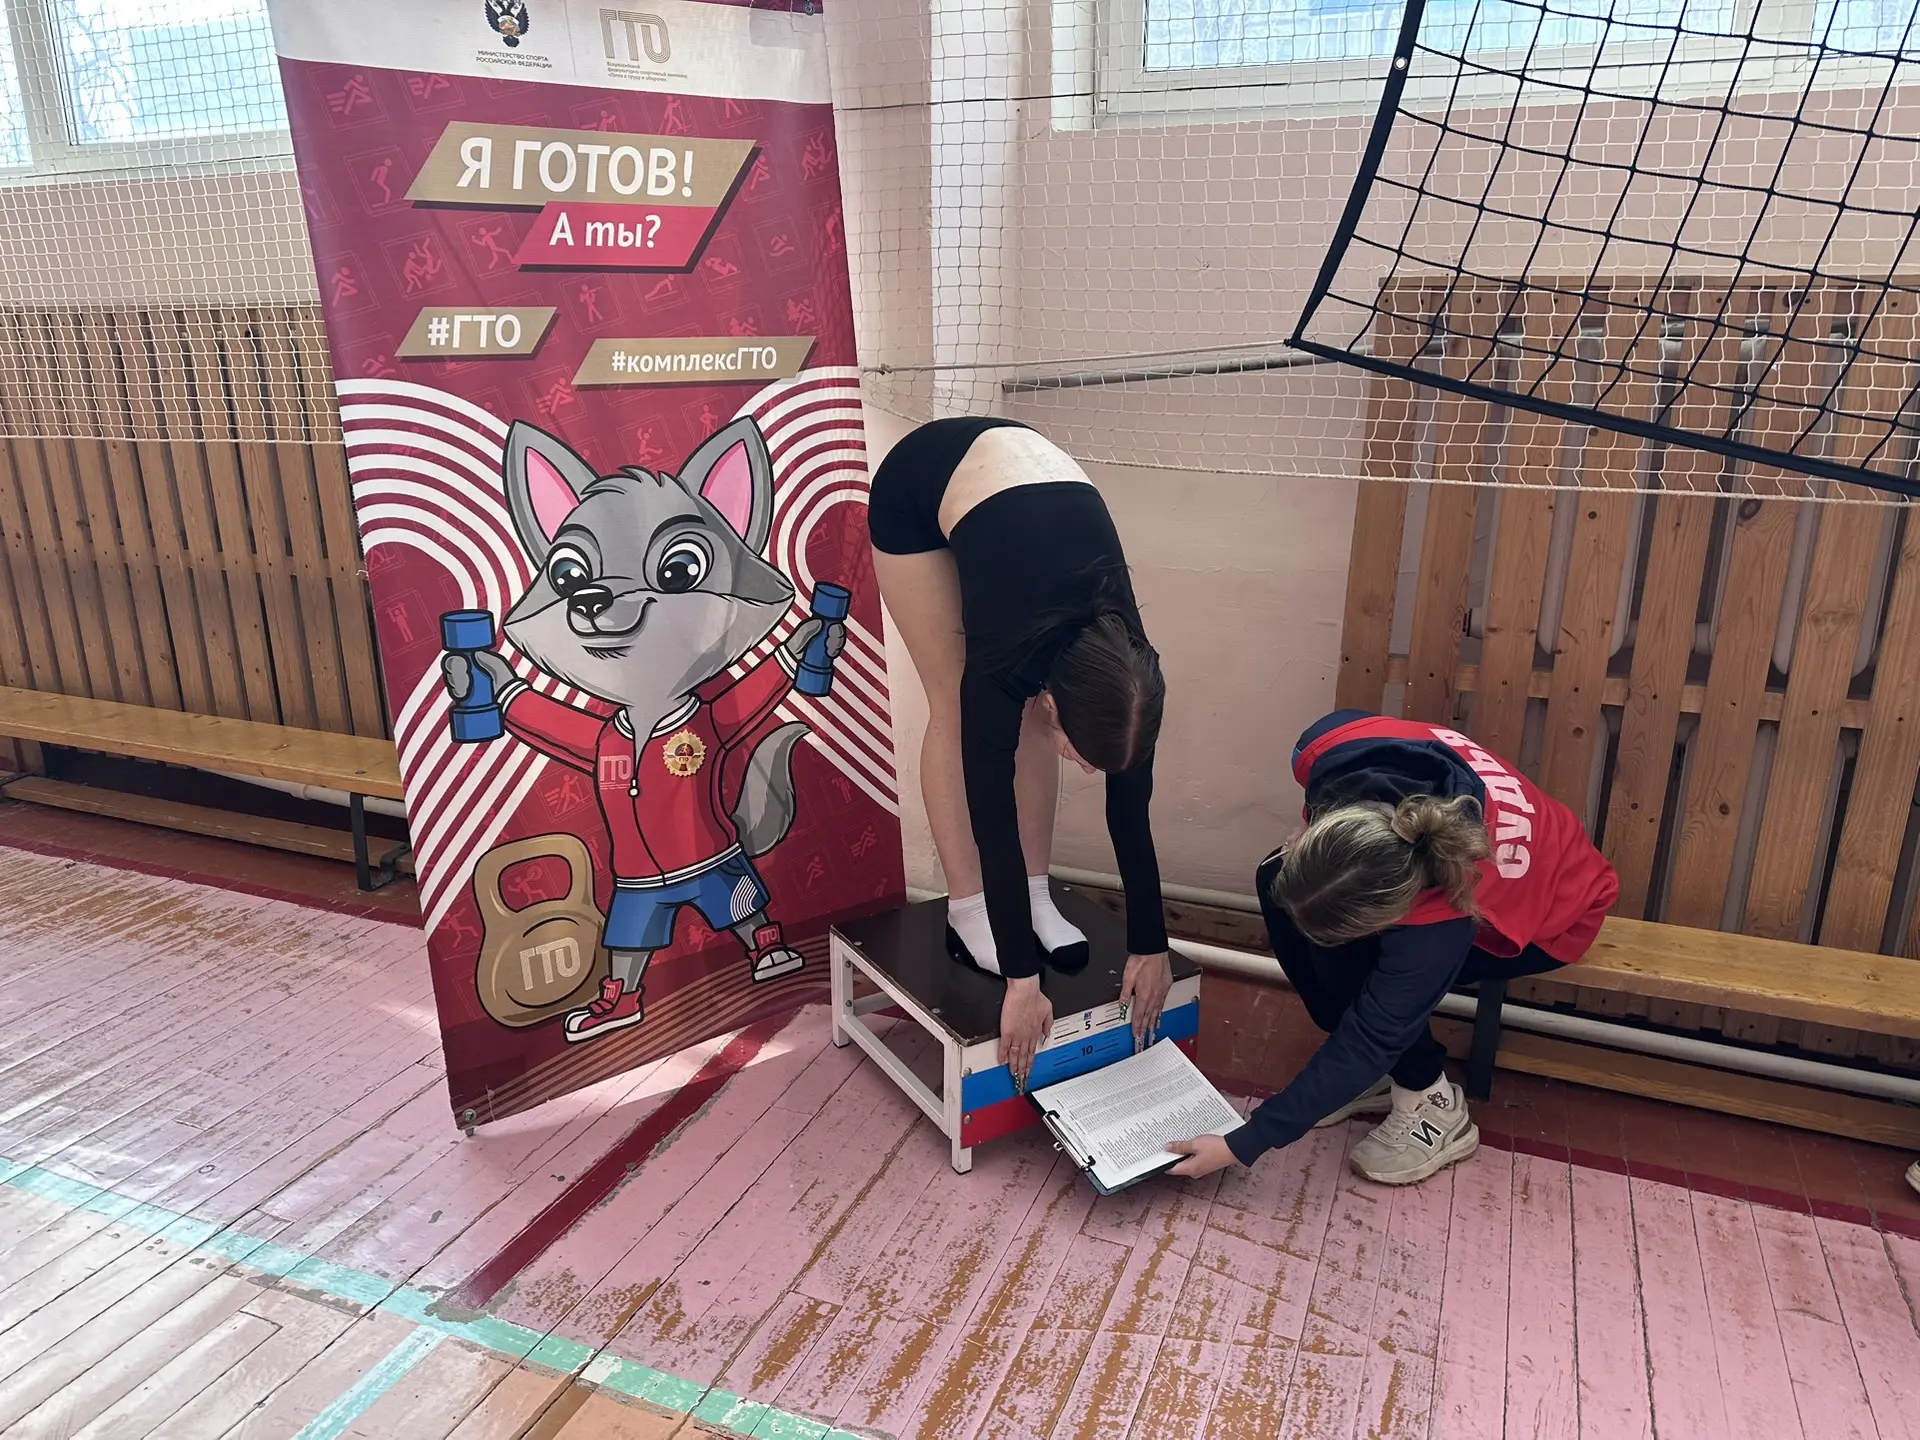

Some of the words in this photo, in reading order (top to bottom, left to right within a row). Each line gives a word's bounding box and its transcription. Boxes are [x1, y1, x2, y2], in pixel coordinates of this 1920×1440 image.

[600, 8, 671, 64] ГТО
[476, 56, 517, 65] РОССИЙСКОЙ
[517, 61, 553, 69] ФЕДЕРАЦИИ
[477, 50, 525, 60] МИНИСТЕРСТВО
[525, 54, 549, 62] СПОРТА
[456, 136, 493, 189] Я
[512, 139, 695, 198] ГОТОВ!
[549, 212, 575, 246] А
[585, 214, 662, 249] ты?
[427, 313, 522, 348] #ГТО
[611, 346, 778, 373] #комплексГТО
[599, 754, 632, 781] ГТО
[1428, 728, 1536, 879] СУДЬЯ
[759, 928, 778, 945] ГТО
[519, 937, 581, 991] ГТО
[1084, 1020, 1091, 1031] 5
[1080, 1045, 1093, 1057] 10
